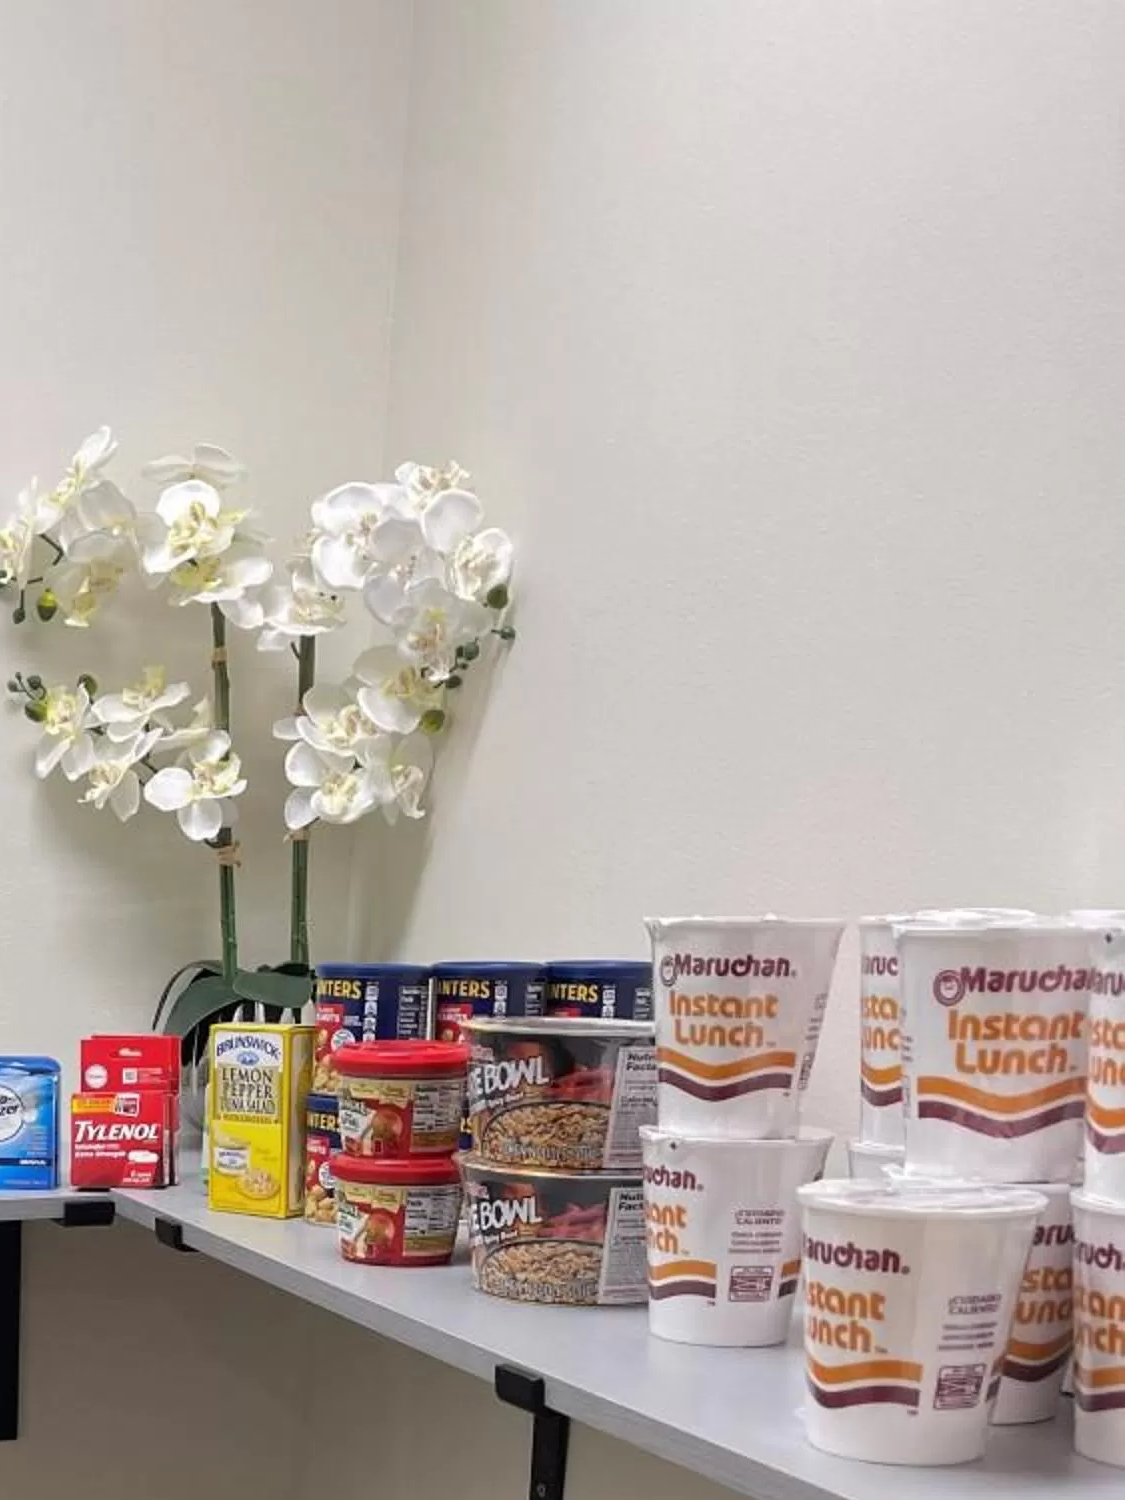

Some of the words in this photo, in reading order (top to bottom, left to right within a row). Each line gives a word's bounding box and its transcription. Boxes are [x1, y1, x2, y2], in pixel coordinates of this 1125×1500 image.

[675, 954, 790, 977] Maruchan
[961, 965, 1090, 993] Marucha
[317, 979, 362, 1000] NTERS
[669, 991, 779, 1018] Instant
[675, 1020, 764, 1047] Lunch
[948, 1009, 1085, 1041] Instant
[216, 1035, 280, 1060] BRUNSWICK
[955, 1042, 1068, 1074] Lunch
[222, 1067, 273, 1083] LEMON
[484, 1055, 550, 1095] BOWL
[223, 1082, 273, 1099] PEPPER
[74, 1119, 161, 1142] TYLENOL
[480, 1196, 542, 1231] BOWL
[803, 1233, 900, 1273] aruchan
[809, 1280, 886, 1321] stant
[810, 1316, 872, 1353] unch
